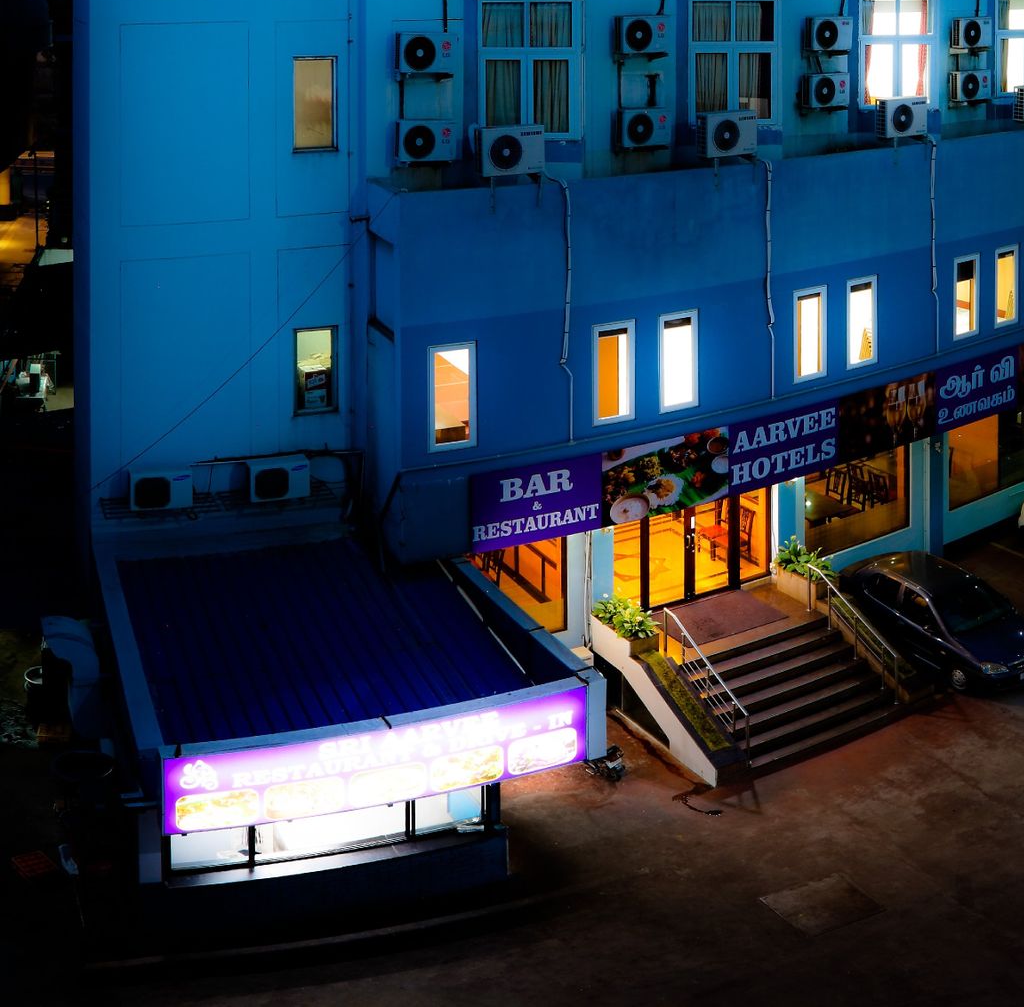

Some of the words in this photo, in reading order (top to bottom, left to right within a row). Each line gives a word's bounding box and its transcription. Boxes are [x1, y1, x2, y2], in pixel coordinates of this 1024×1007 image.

[939, 364, 985, 399] ஆர்
[989, 355, 1015, 383] வி
[937, 385, 1016, 424] உணவகம்
[732, 407, 836, 454] AARVEE
[731, 437, 836, 486] HOTELS
[500, 469, 573, 502] BAR
[472, 503, 599, 542] RESTAURANT
[532, 500, 543, 511] &
[548, 711, 573, 729] IN
